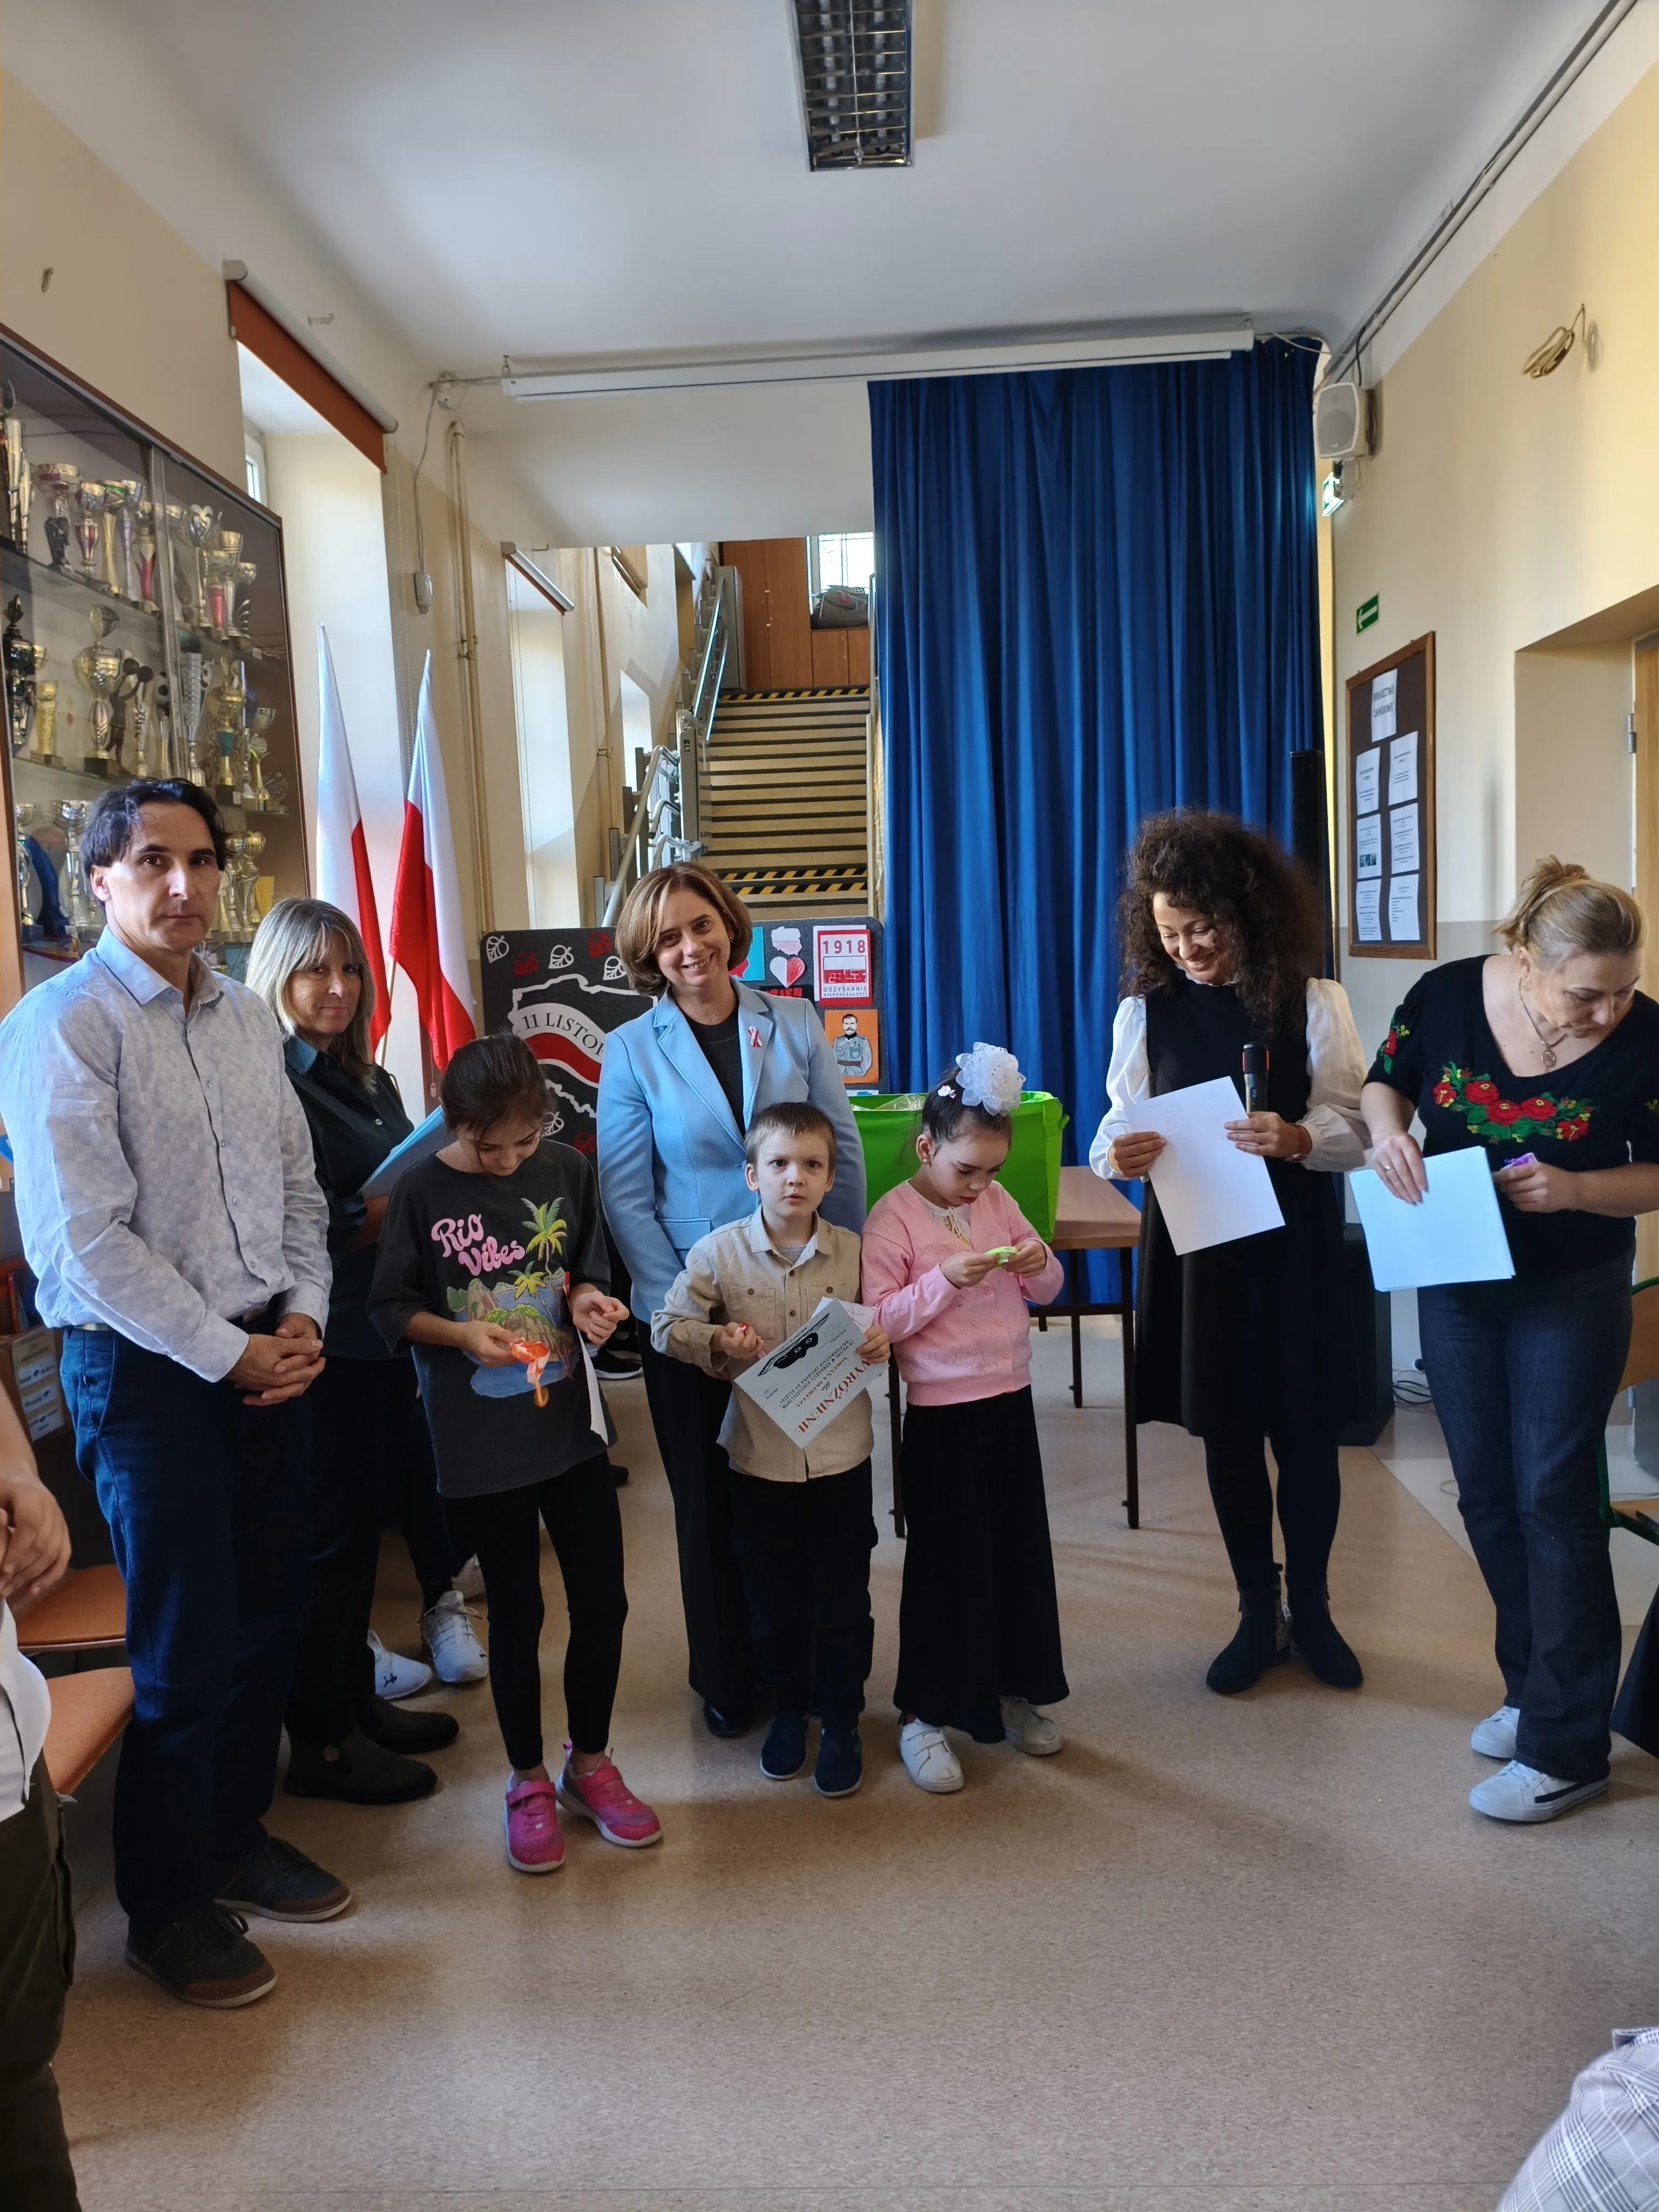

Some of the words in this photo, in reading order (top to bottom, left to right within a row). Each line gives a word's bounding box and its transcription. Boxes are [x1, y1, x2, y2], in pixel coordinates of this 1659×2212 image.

[822, 940, 866, 954] 1918
[522, 1014, 540, 1030] 11
[431, 1214, 484, 1257] Rio
[458, 1236, 525, 1276] Vibes
